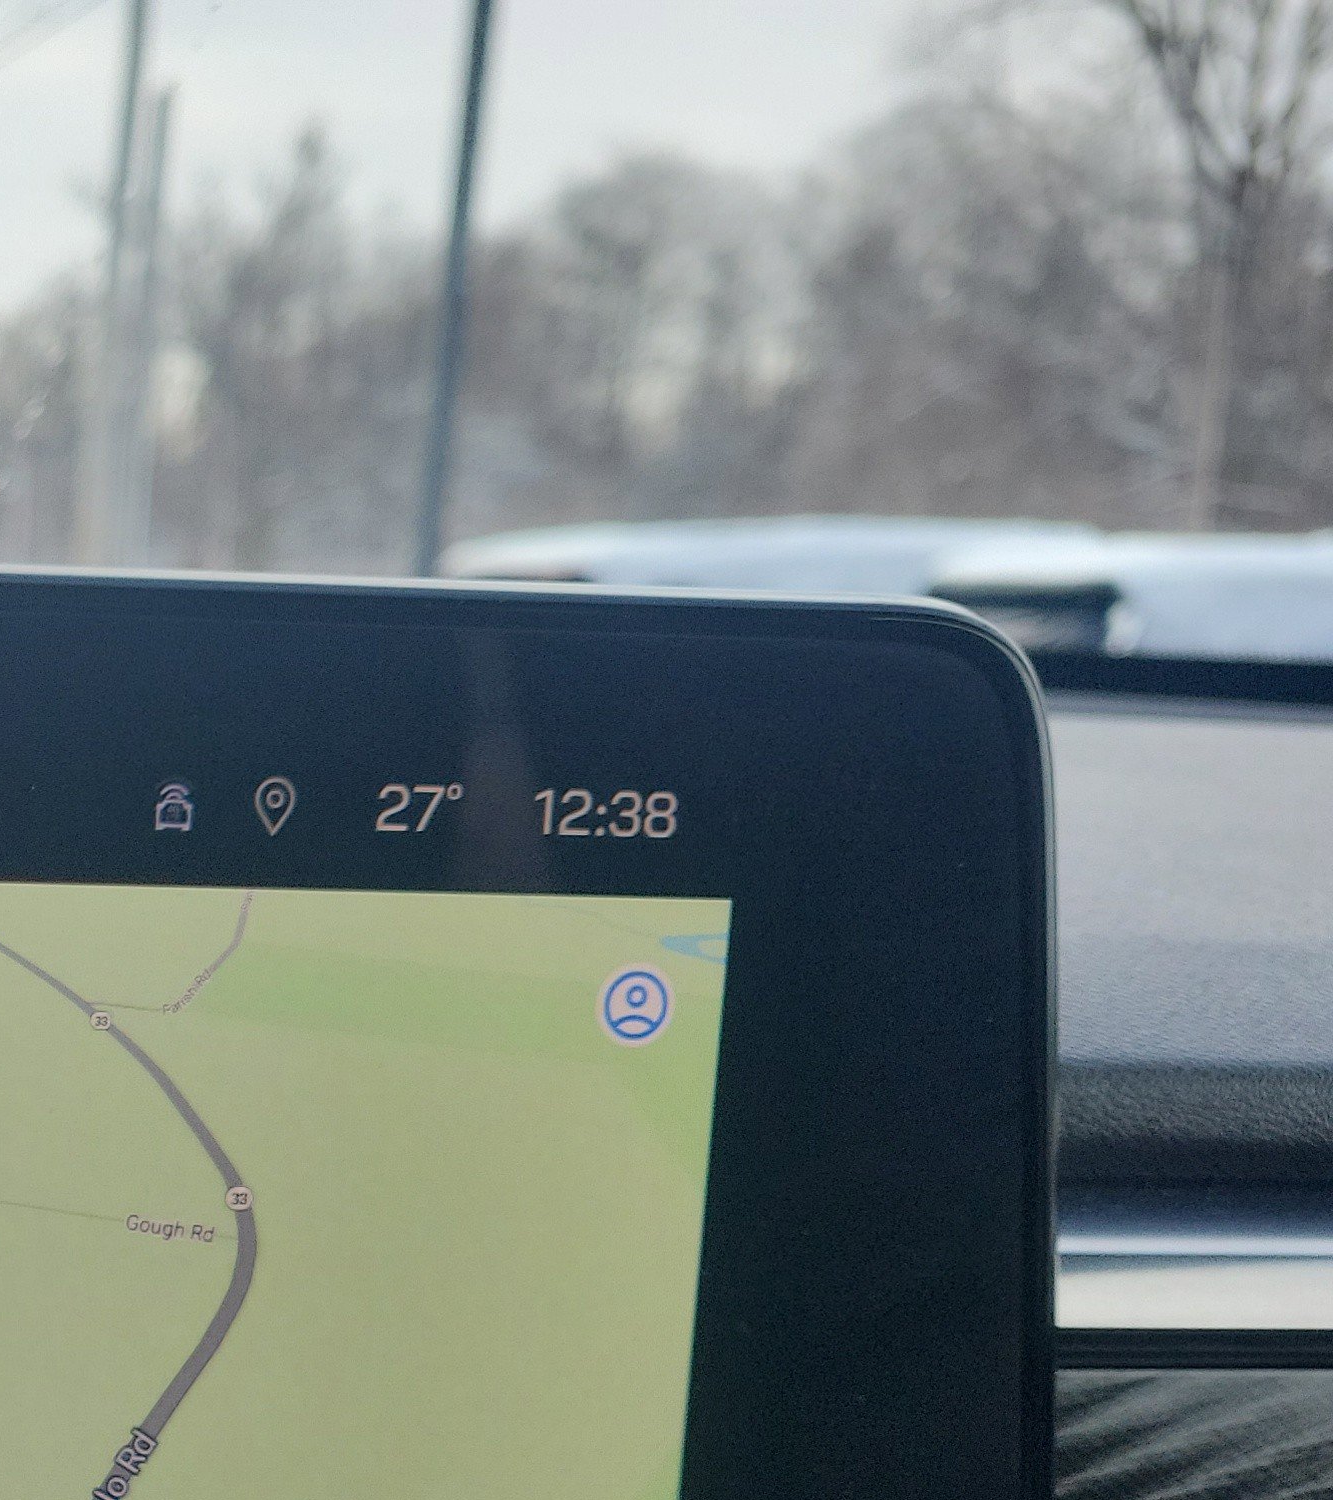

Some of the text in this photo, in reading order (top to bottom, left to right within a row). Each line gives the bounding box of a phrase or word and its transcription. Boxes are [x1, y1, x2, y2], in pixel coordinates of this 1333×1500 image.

[375, 782, 464, 832] 27°
[534, 788, 679, 839] 12:38
[94, 1016, 109, 1027] 33
[232, 1193, 248, 1206] 33
[125, 1214, 215, 1243] Gough Rd
[116, 1428, 157, 1473] Rd
